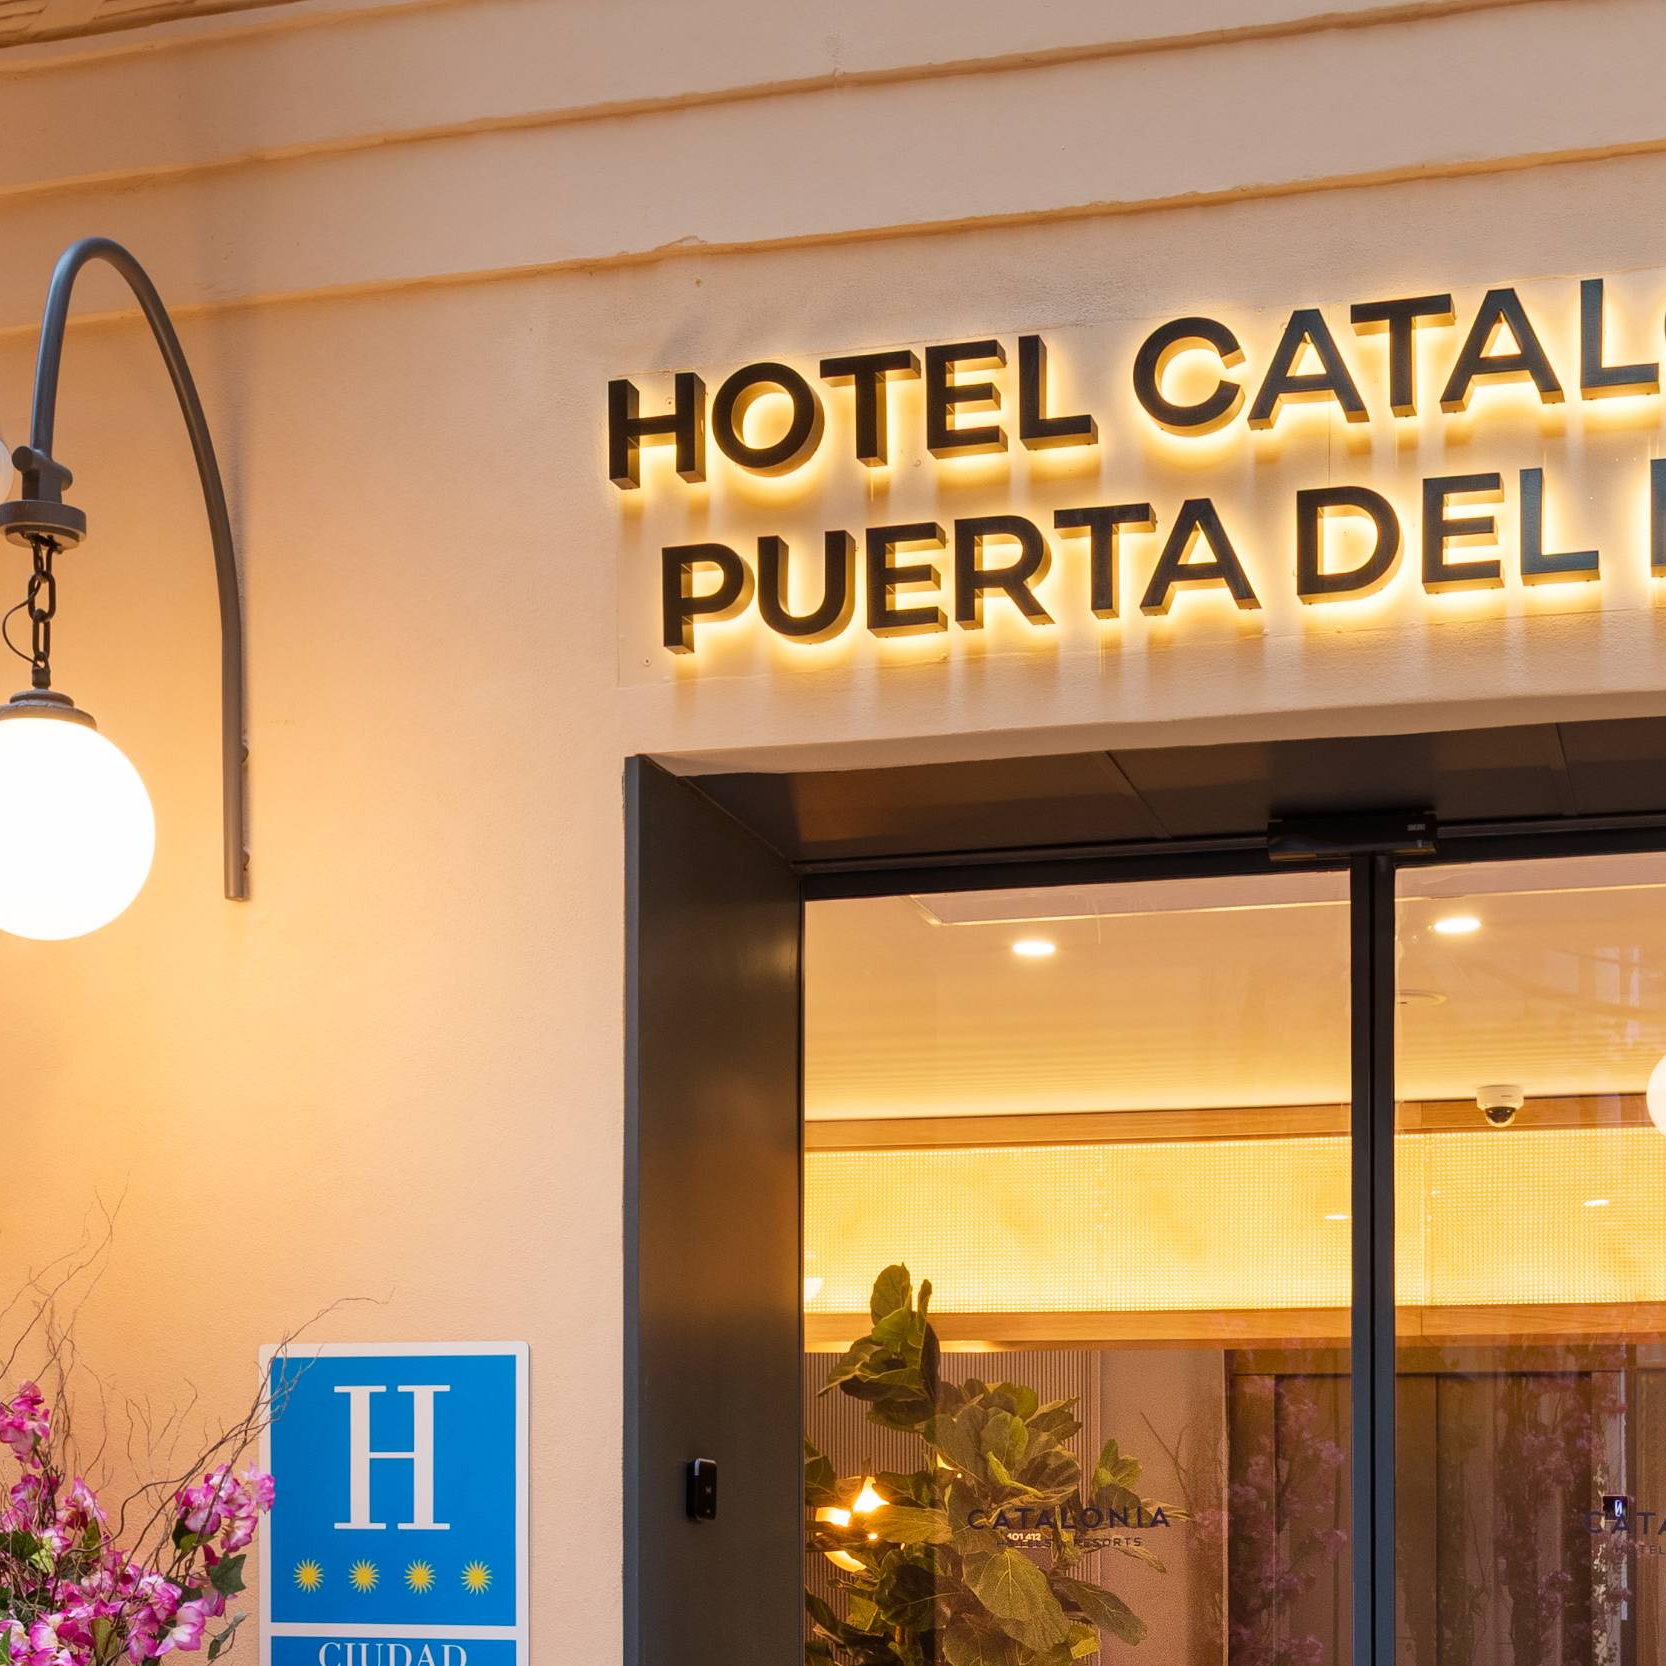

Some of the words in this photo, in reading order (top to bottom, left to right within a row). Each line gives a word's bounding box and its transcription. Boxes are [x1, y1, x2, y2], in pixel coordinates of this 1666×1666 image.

[608, 334, 1099, 490] HOTEL
[661, 497, 1262, 655] PUERTA
[1296, 467, 1600, 605] DEL
[333, 1384, 451, 1530] H
[966, 1505, 1171, 1531] CATALONIA
